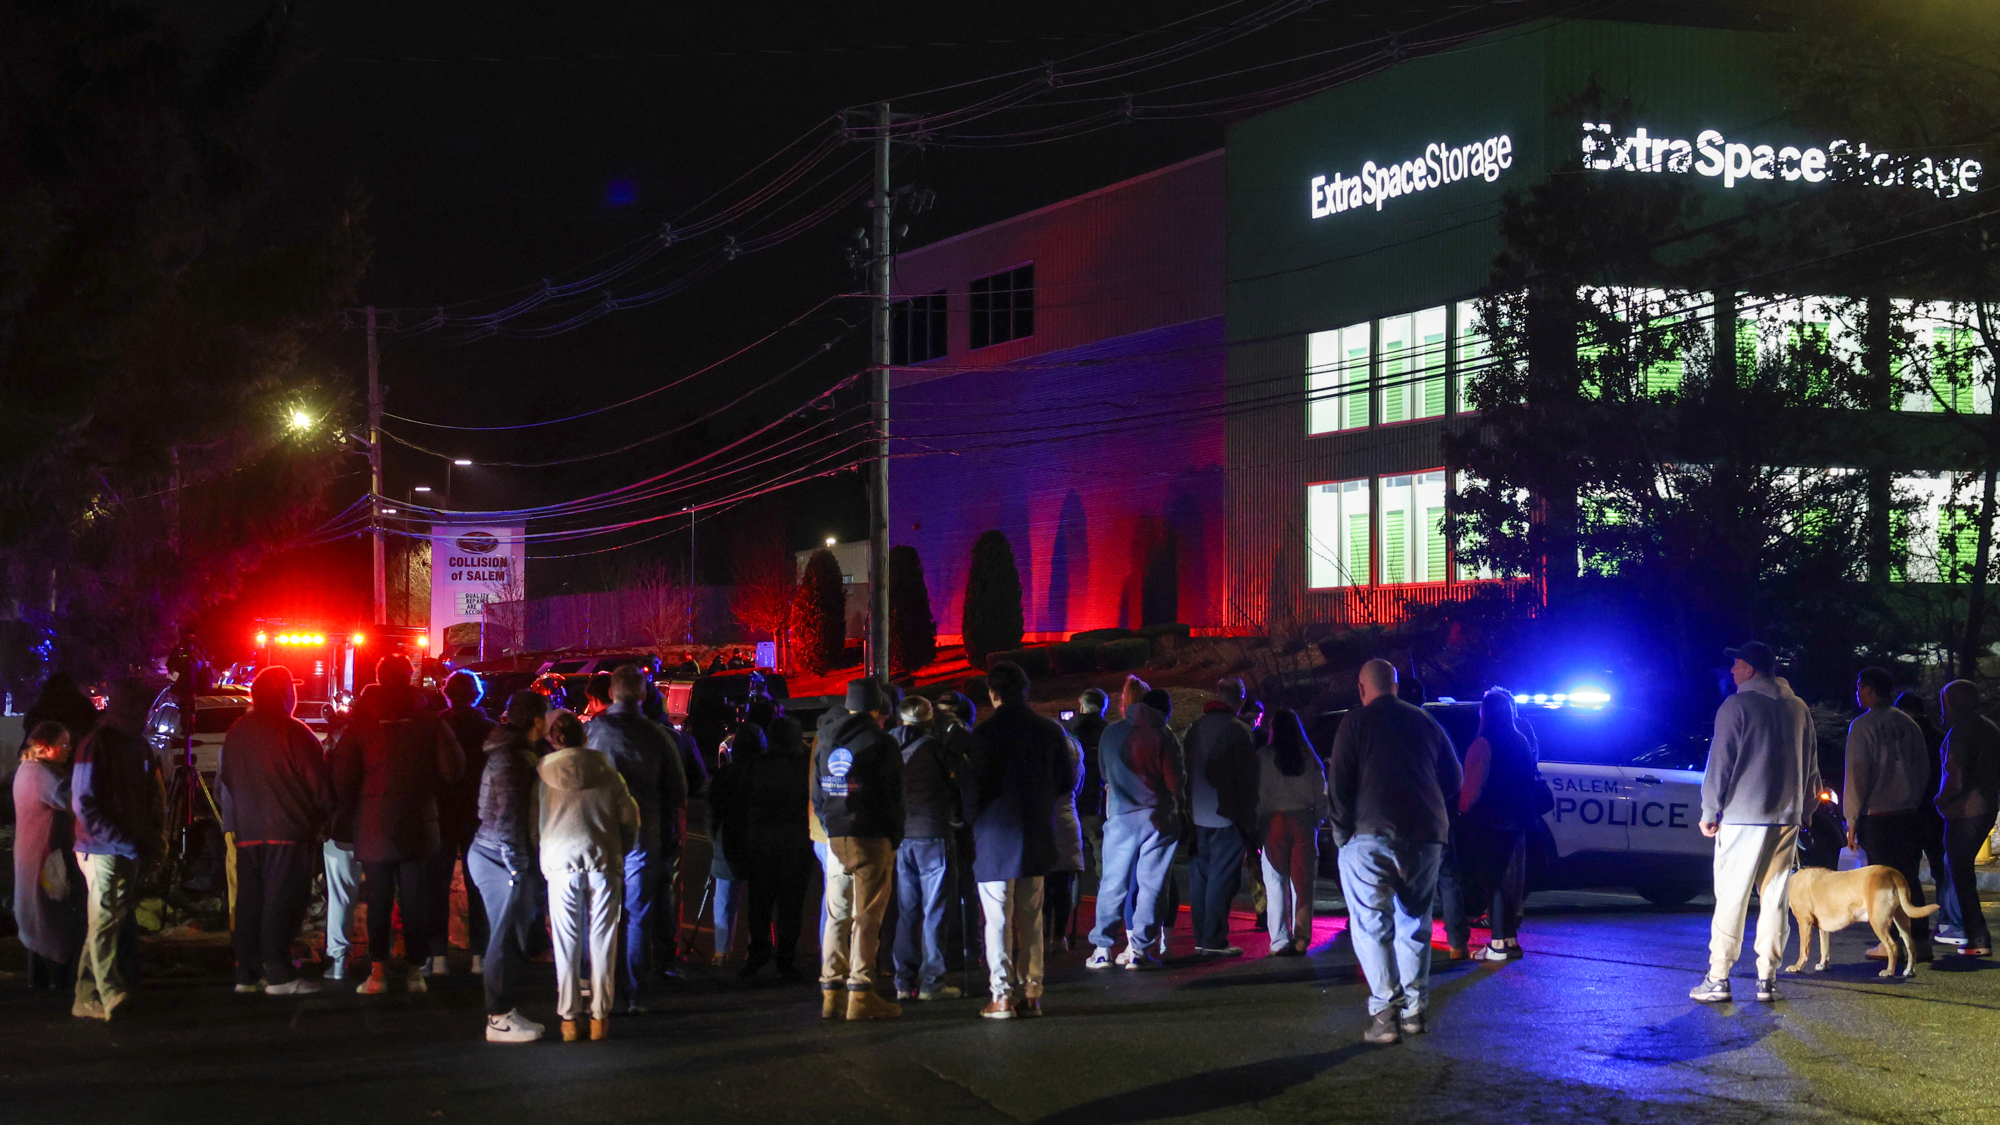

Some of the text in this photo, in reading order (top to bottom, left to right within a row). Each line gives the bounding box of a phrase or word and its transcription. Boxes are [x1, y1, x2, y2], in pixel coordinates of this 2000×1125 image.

[449, 557, 508, 568] COLLISION
[451, 571, 505, 581] of SALEM
[1552, 778, 1619, 794] SALEM
[1555, 797, 1689, 829] POLICE
